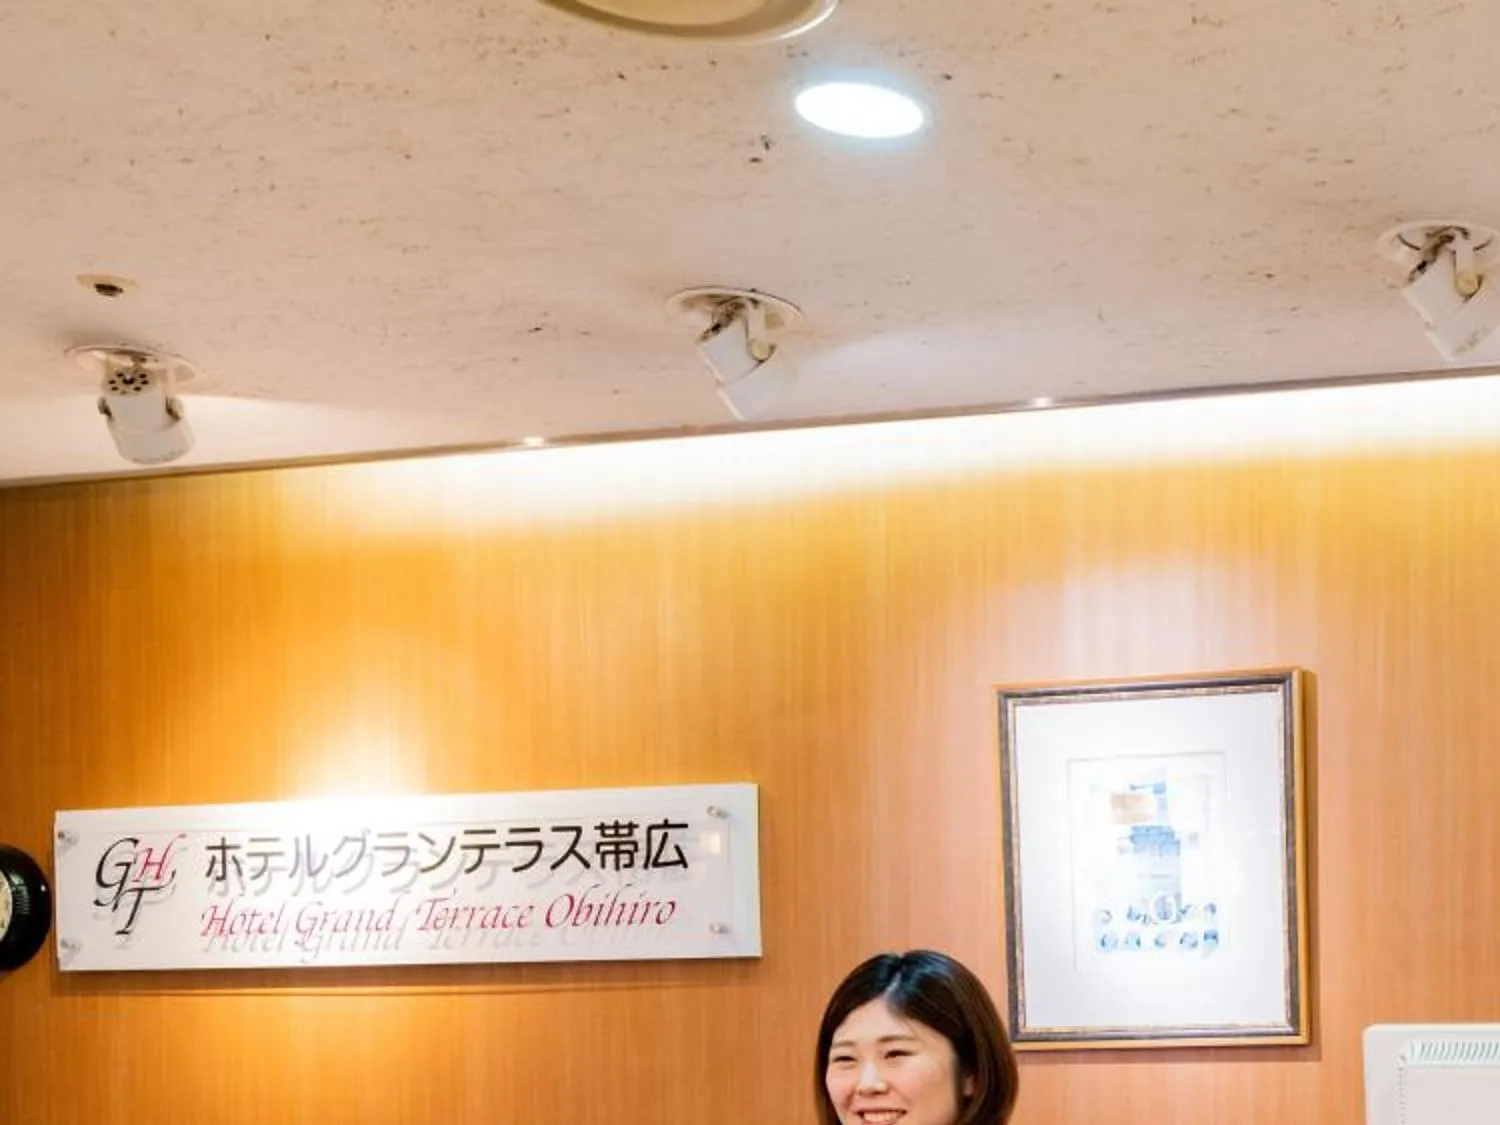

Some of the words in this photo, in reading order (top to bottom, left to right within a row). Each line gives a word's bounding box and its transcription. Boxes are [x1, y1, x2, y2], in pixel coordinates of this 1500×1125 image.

[204, 818, 689, 882] ホテルグランテラス帯広
[200, 900, 287, 937] Hotel
[293, 897, 401, 945] Grand
[416, 887, 535, 932] Terrace
[545, 883, 677, 929] Obihiro
